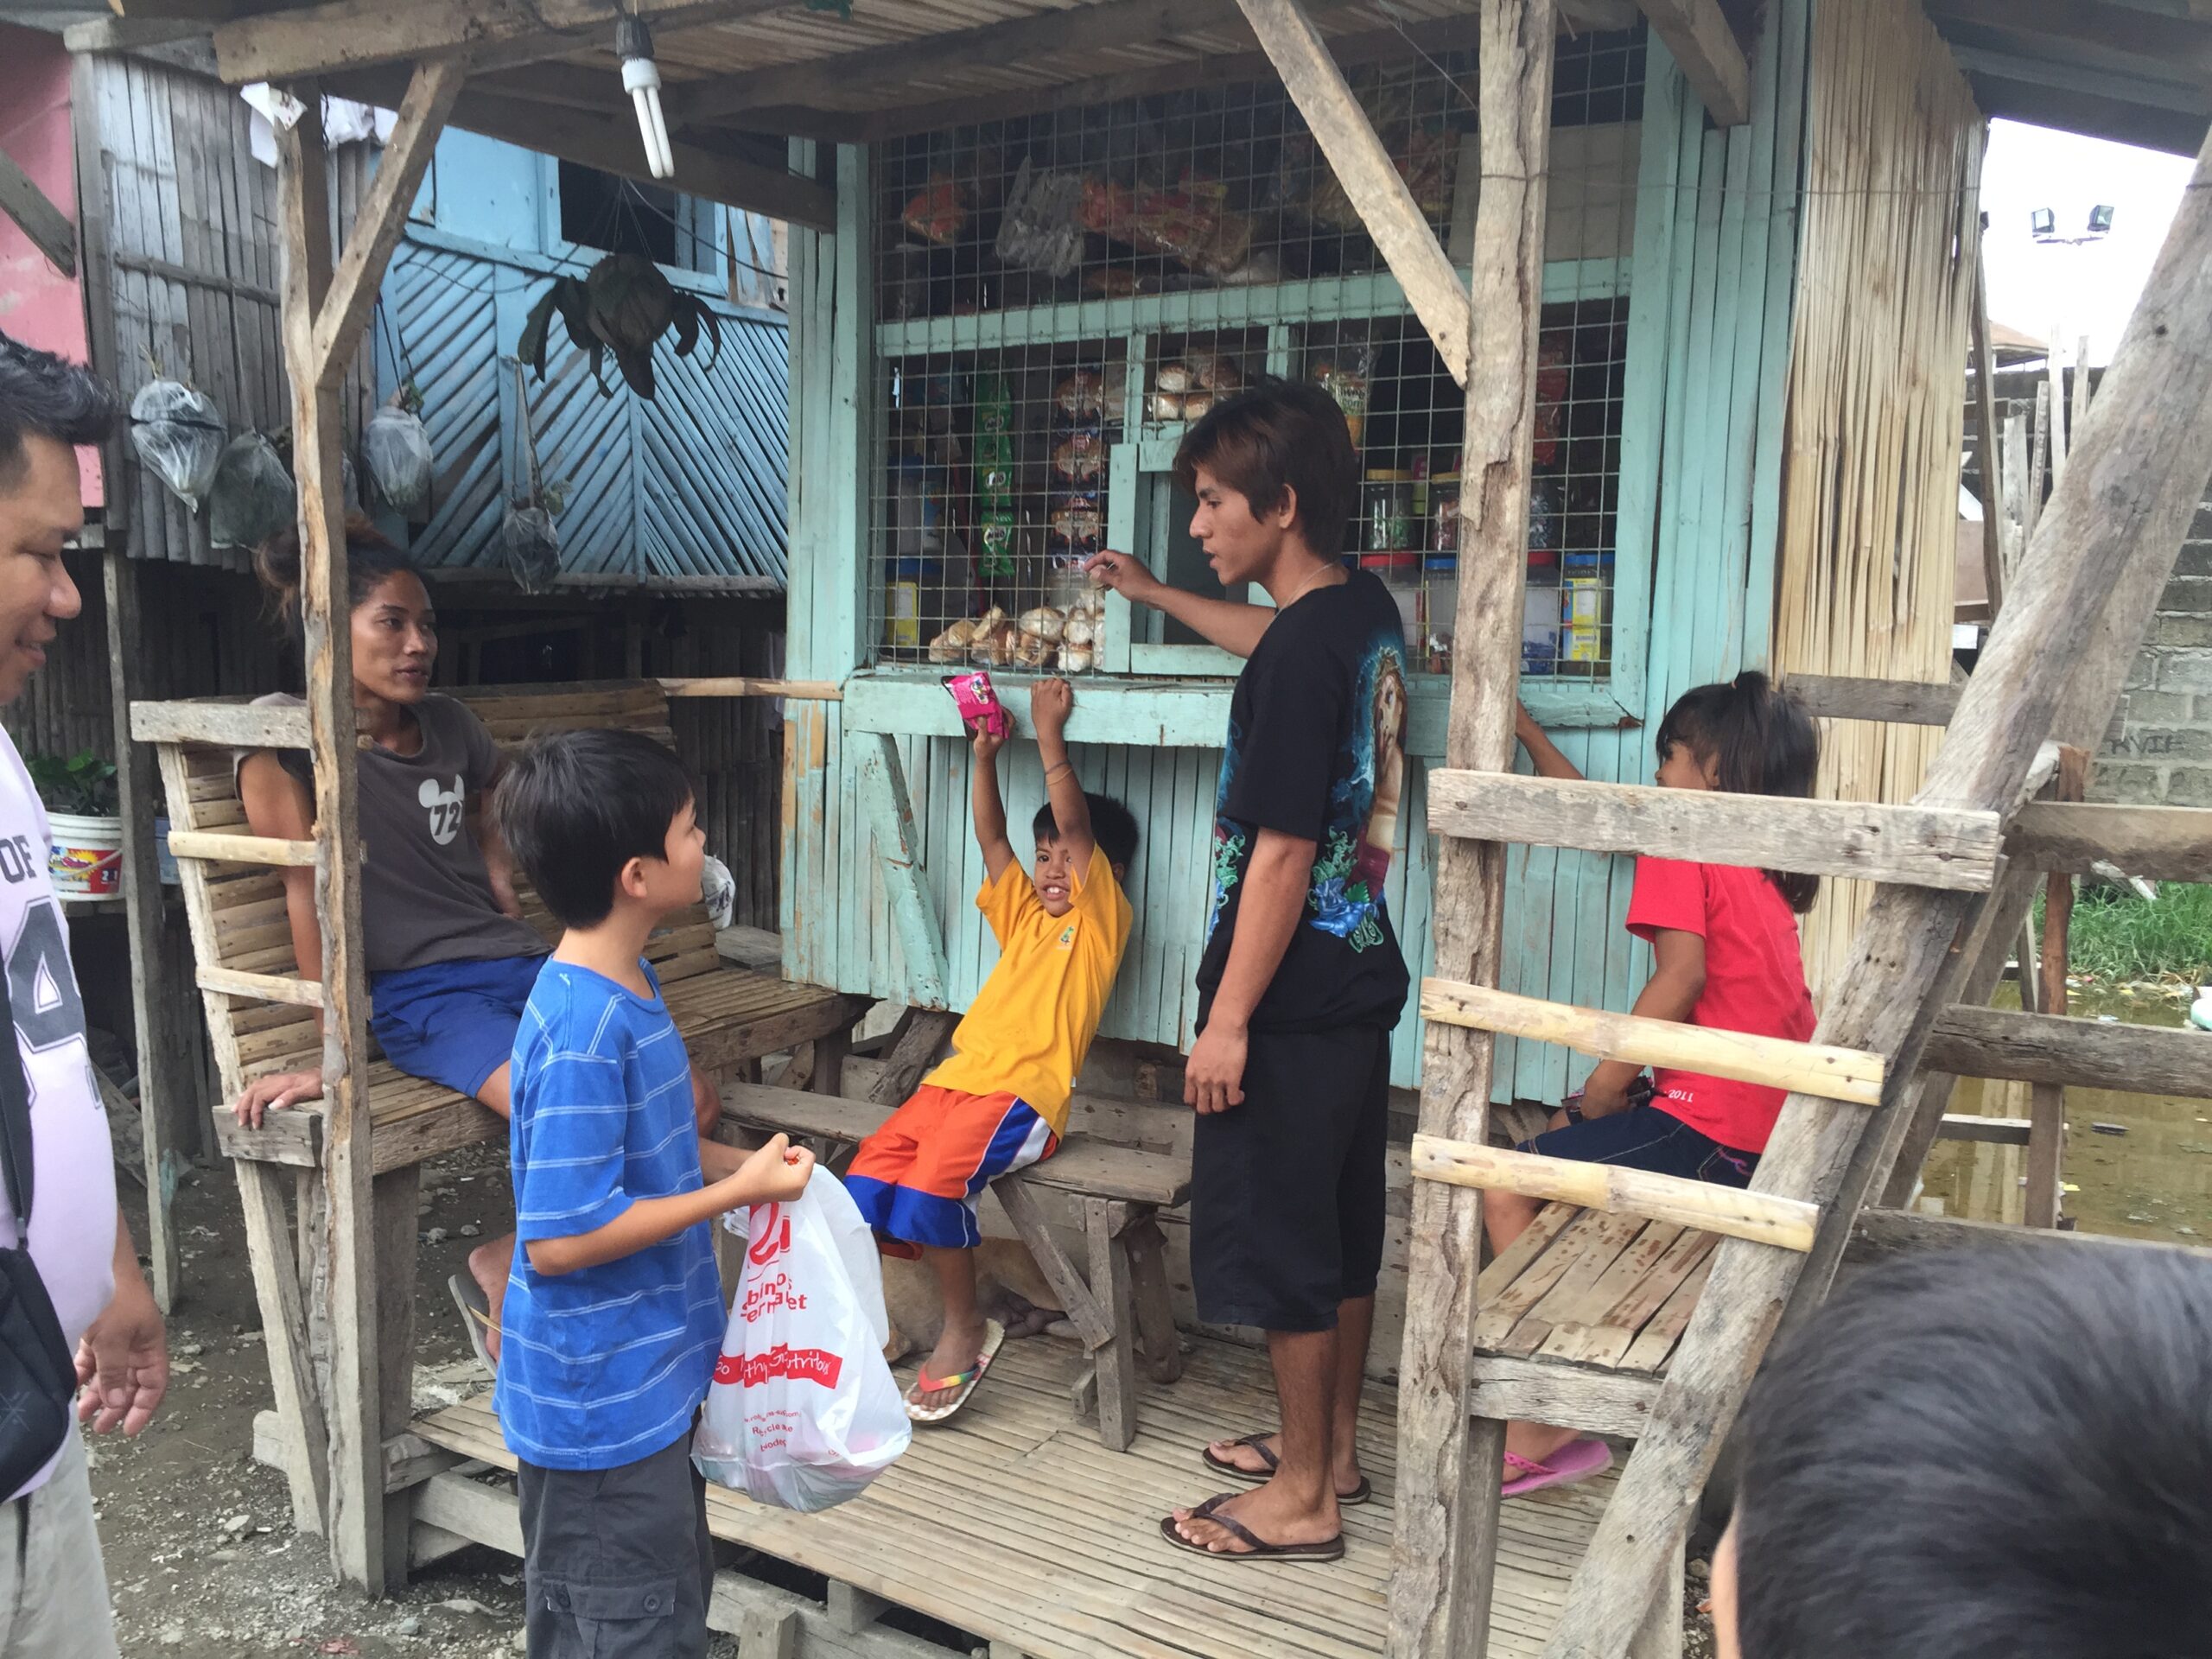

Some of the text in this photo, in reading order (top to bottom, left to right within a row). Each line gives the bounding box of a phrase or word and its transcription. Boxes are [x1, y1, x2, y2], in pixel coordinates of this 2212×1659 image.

[434, 800, 461, 836] 72
[0, 835, 37, 885] OF
[1669, 1089, 1694, 1103] 2011
